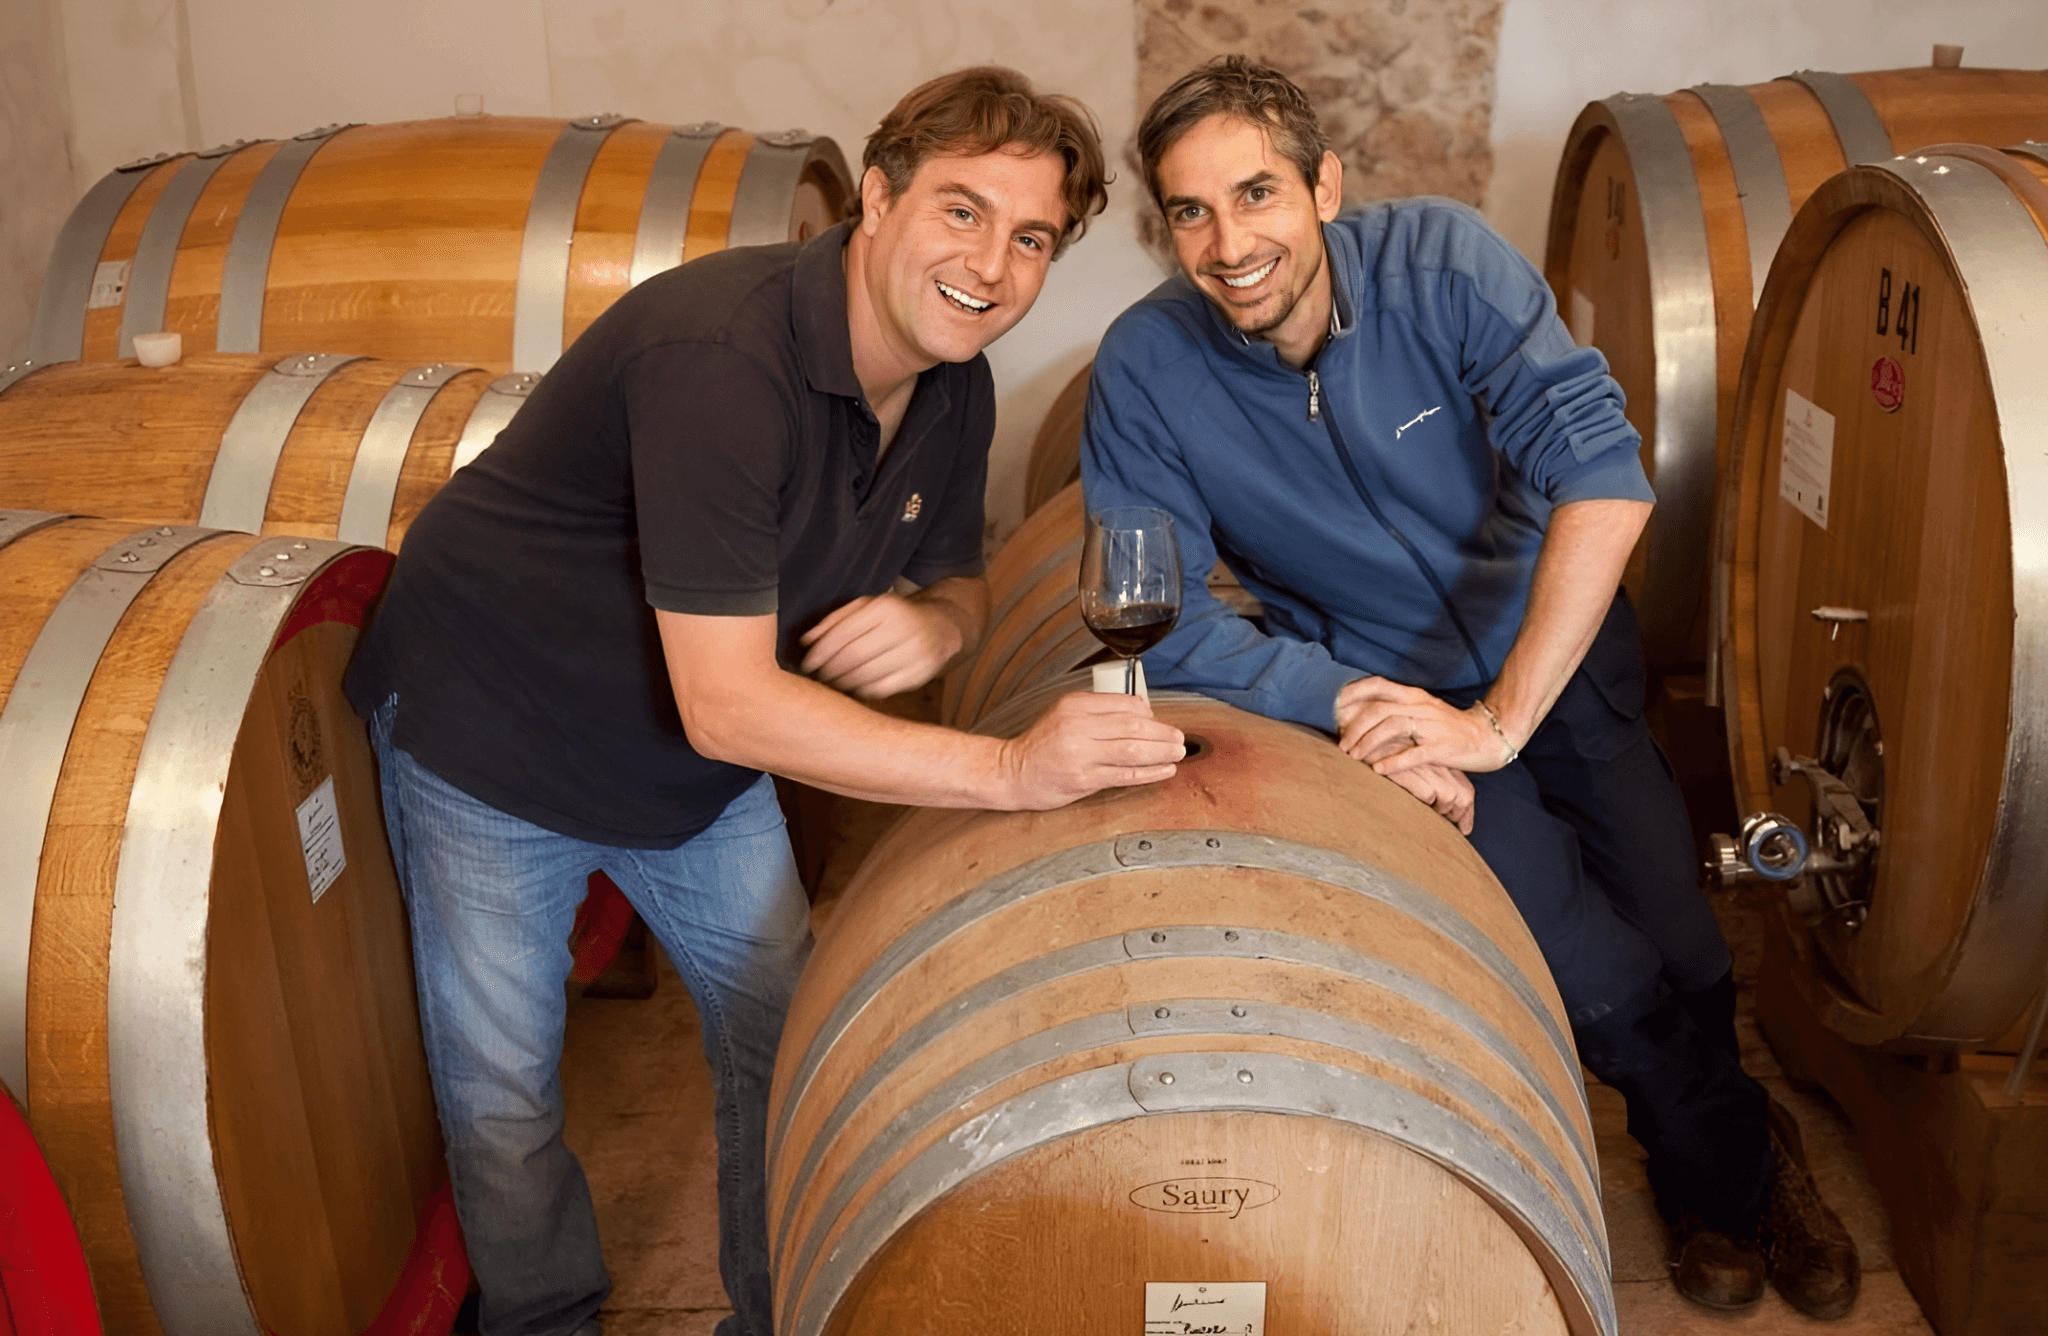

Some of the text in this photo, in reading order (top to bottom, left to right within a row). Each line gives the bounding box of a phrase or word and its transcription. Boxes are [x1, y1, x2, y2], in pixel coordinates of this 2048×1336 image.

[1876, 267, 1920, 354] B 41
[1162, 1184, 1250, 1219] Saury
